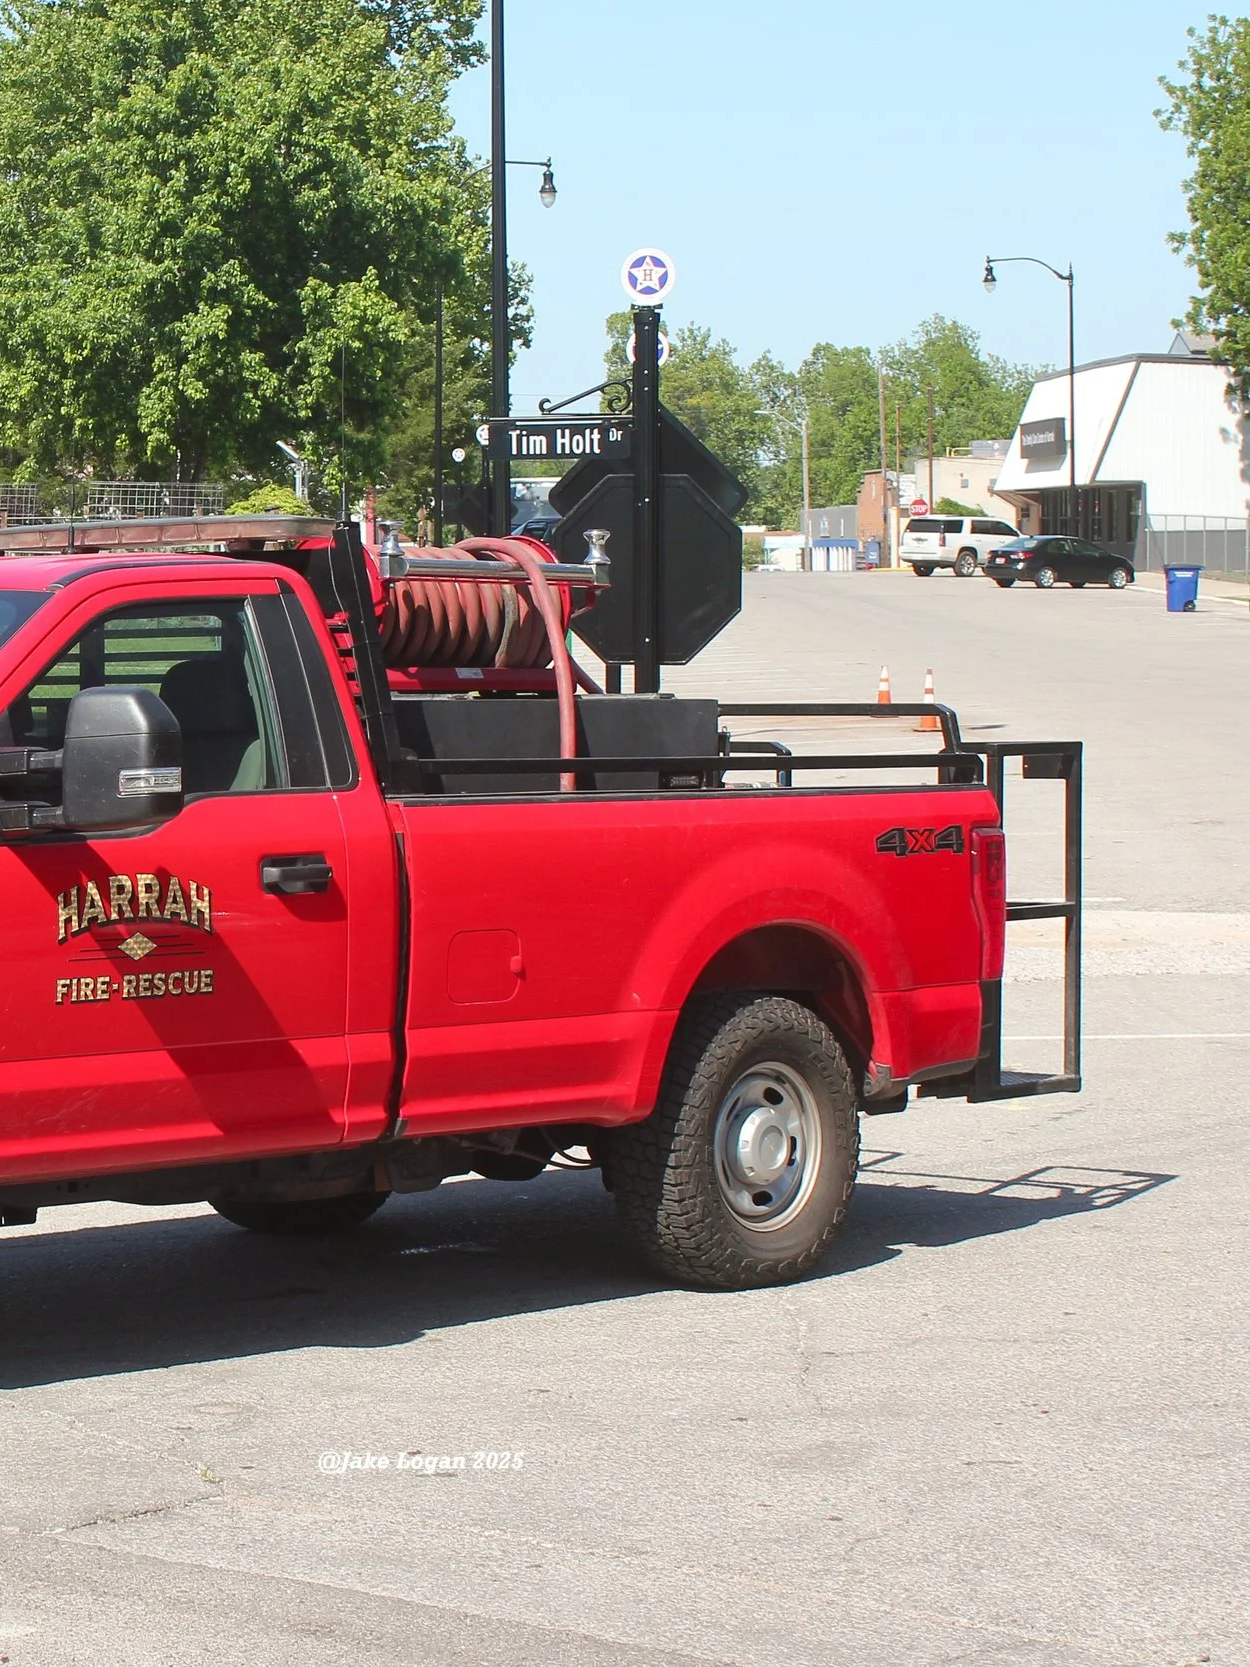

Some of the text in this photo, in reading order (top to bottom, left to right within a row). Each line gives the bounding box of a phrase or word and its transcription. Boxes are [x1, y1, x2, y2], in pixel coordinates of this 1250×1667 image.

[508, 427, 623, 455] Tim Holt Dr
[910, 504, 928, 513] STOP
[56, 872, 214, 945] HARRAH
